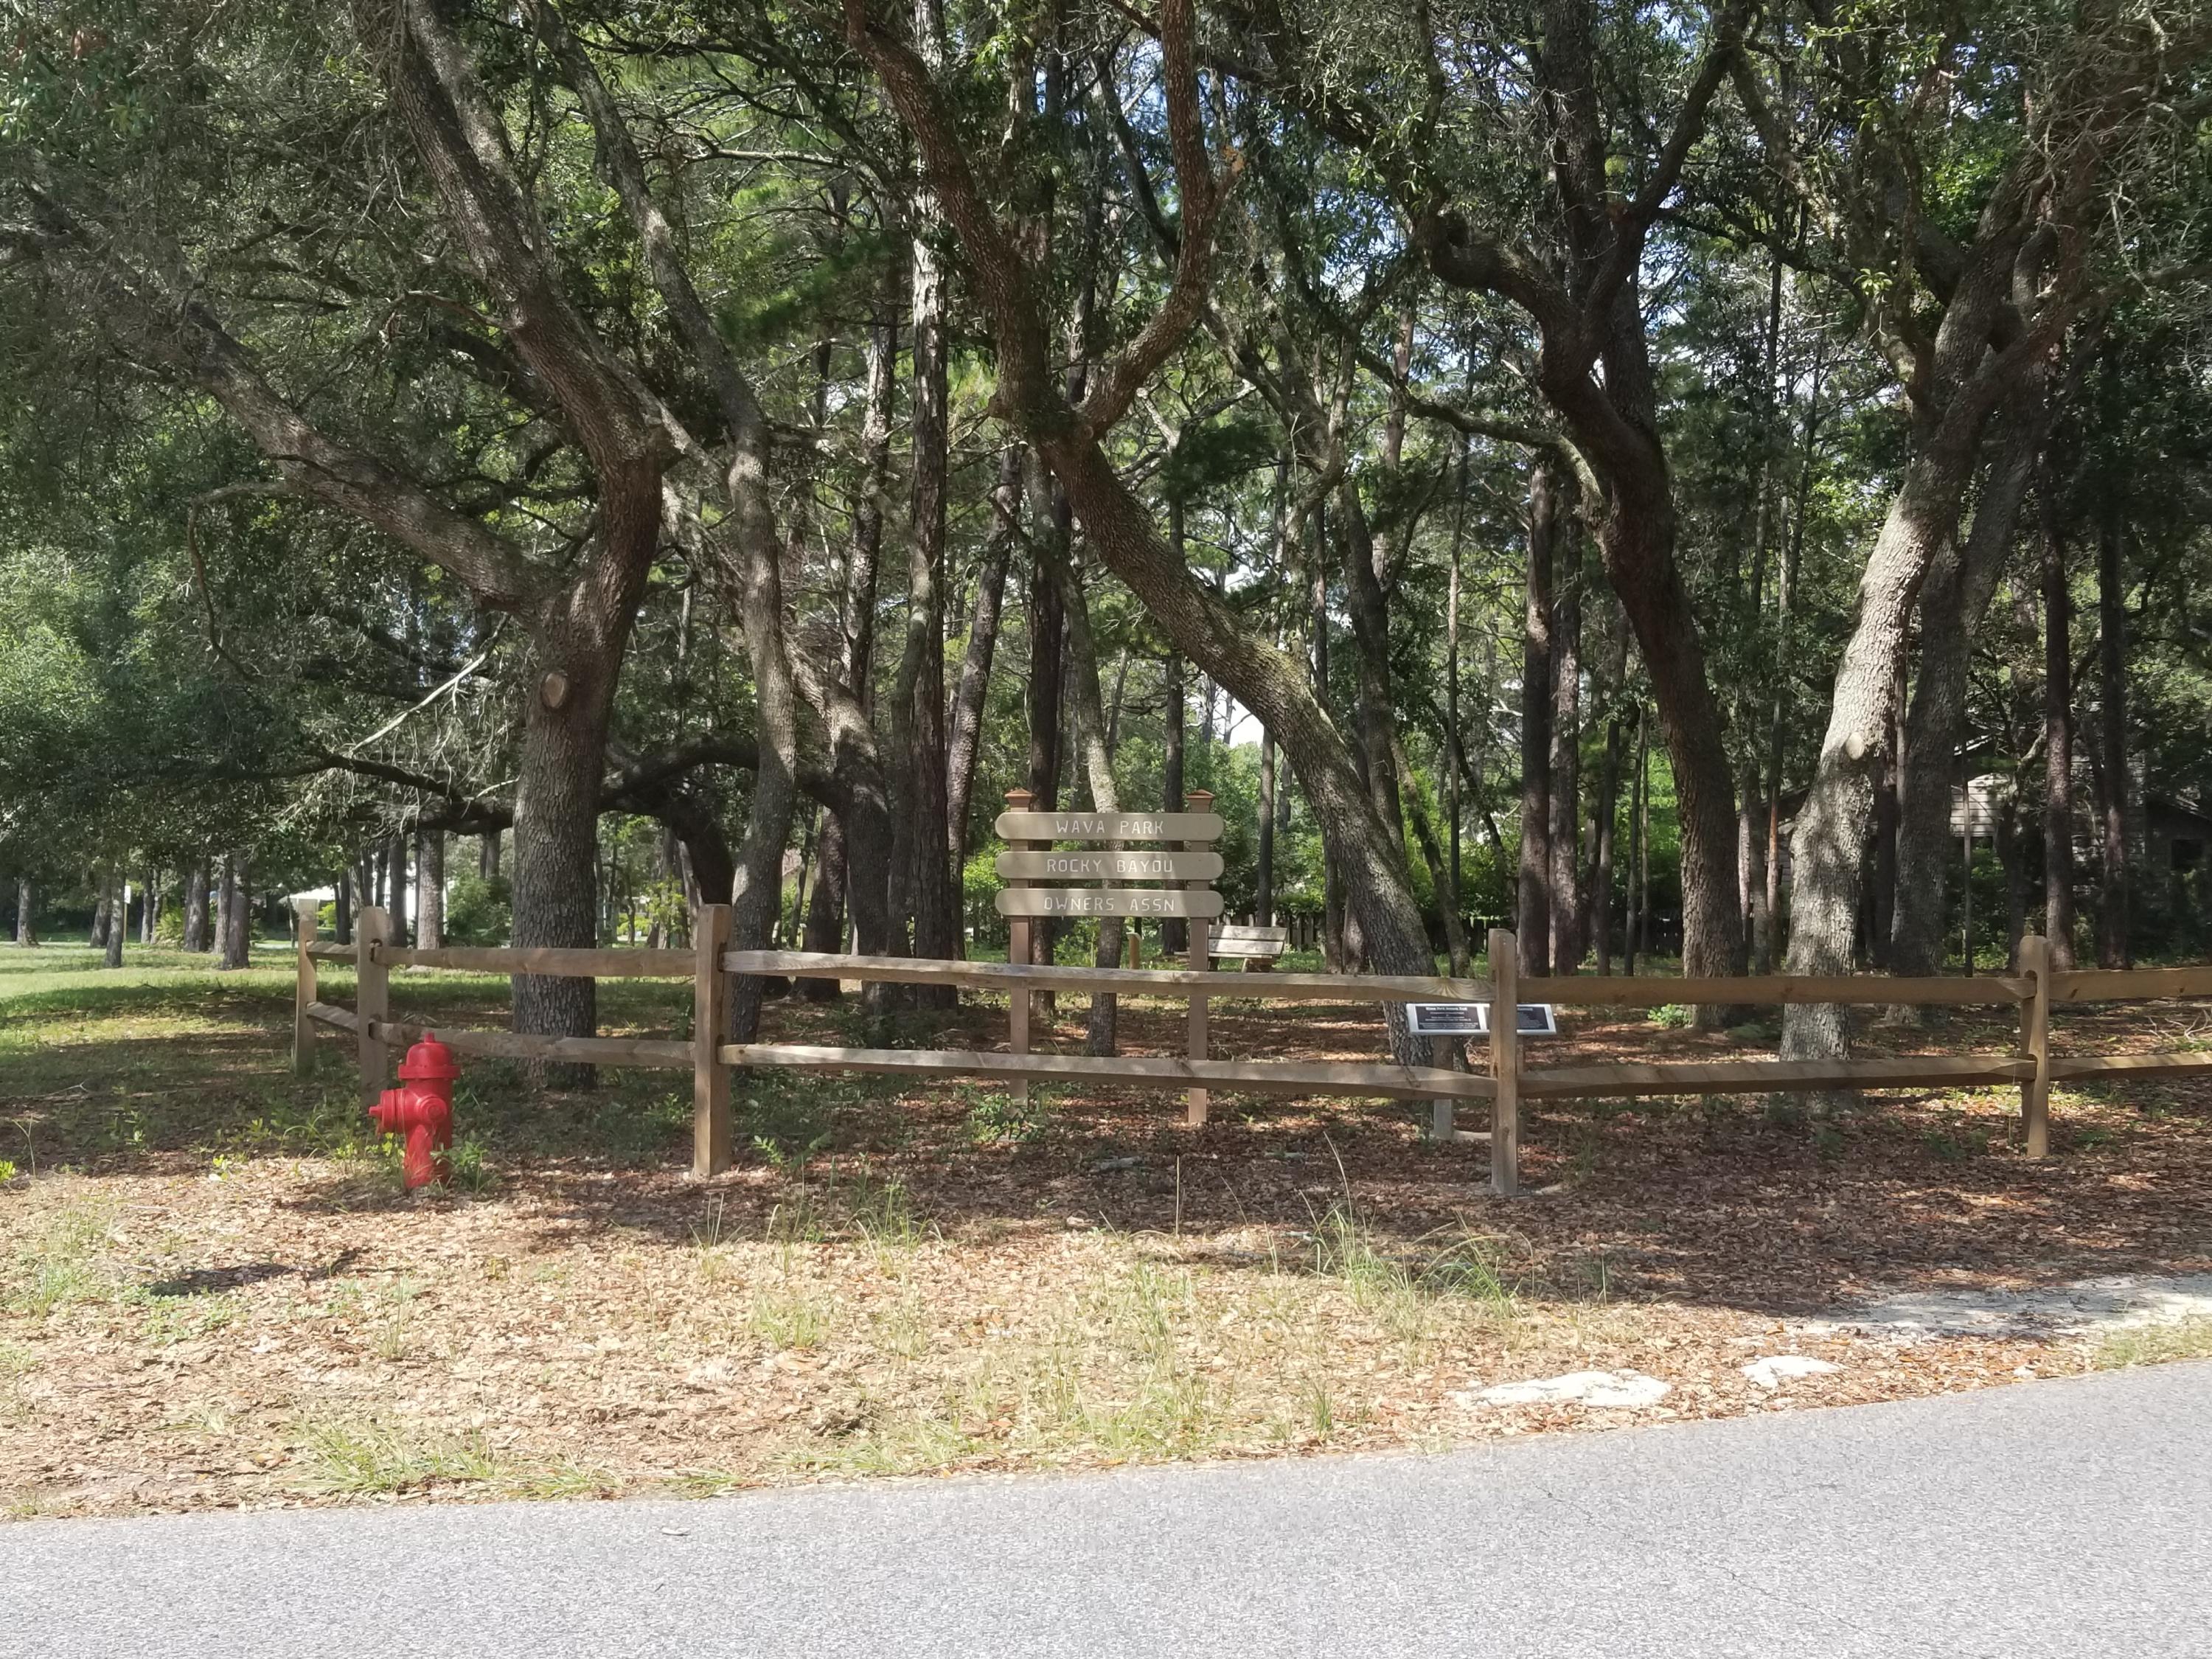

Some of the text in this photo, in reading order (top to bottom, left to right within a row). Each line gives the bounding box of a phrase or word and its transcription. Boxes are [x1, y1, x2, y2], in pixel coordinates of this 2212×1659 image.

[1056, 820, 1164, 835] WAVA PARK
[1047, 858, 1173, 873] ROCKY BAYOU
[1043, 897, 1175, 911] OWNERS ASSN
